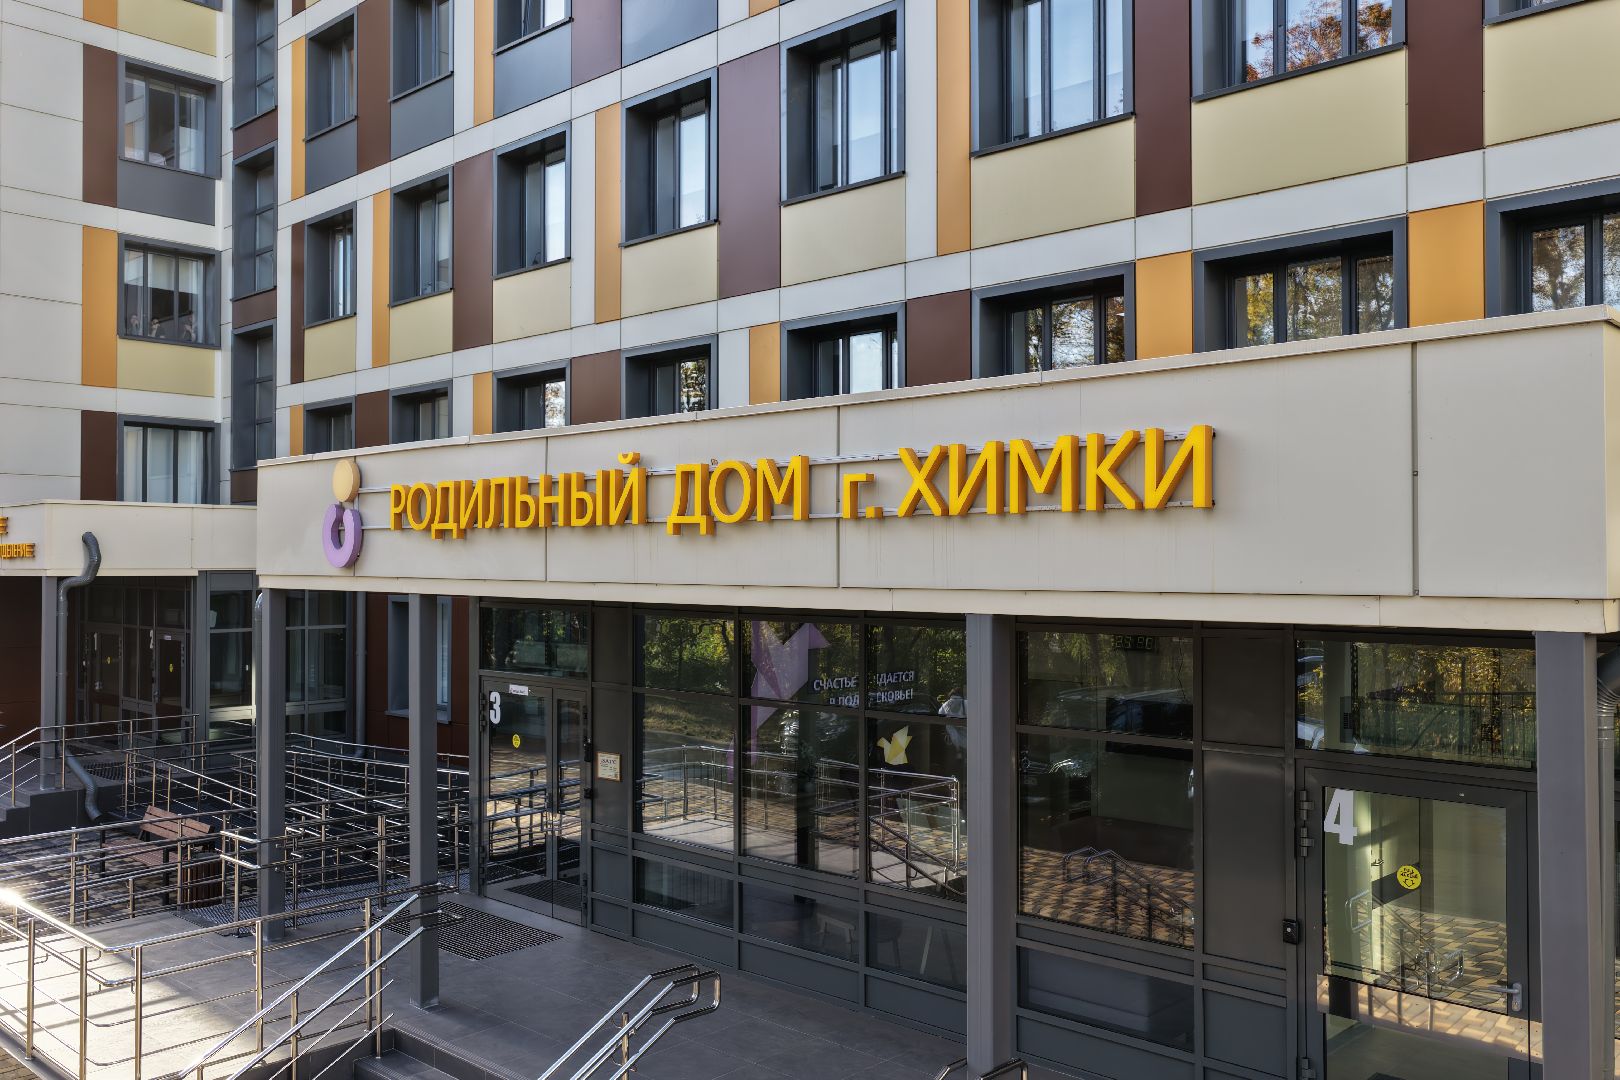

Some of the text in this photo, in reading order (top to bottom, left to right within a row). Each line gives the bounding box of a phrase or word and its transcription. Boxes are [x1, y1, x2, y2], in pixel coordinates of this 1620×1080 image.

[389, 425, 1212, 539] РОДИЛЬНЫЙ ДОМ г. ХИМКИ
[813, 675, 857, 691] СЧАСТЬЕ
[489, 691, 501, 725] 3
[1324, 788, 1358, 845] 4
